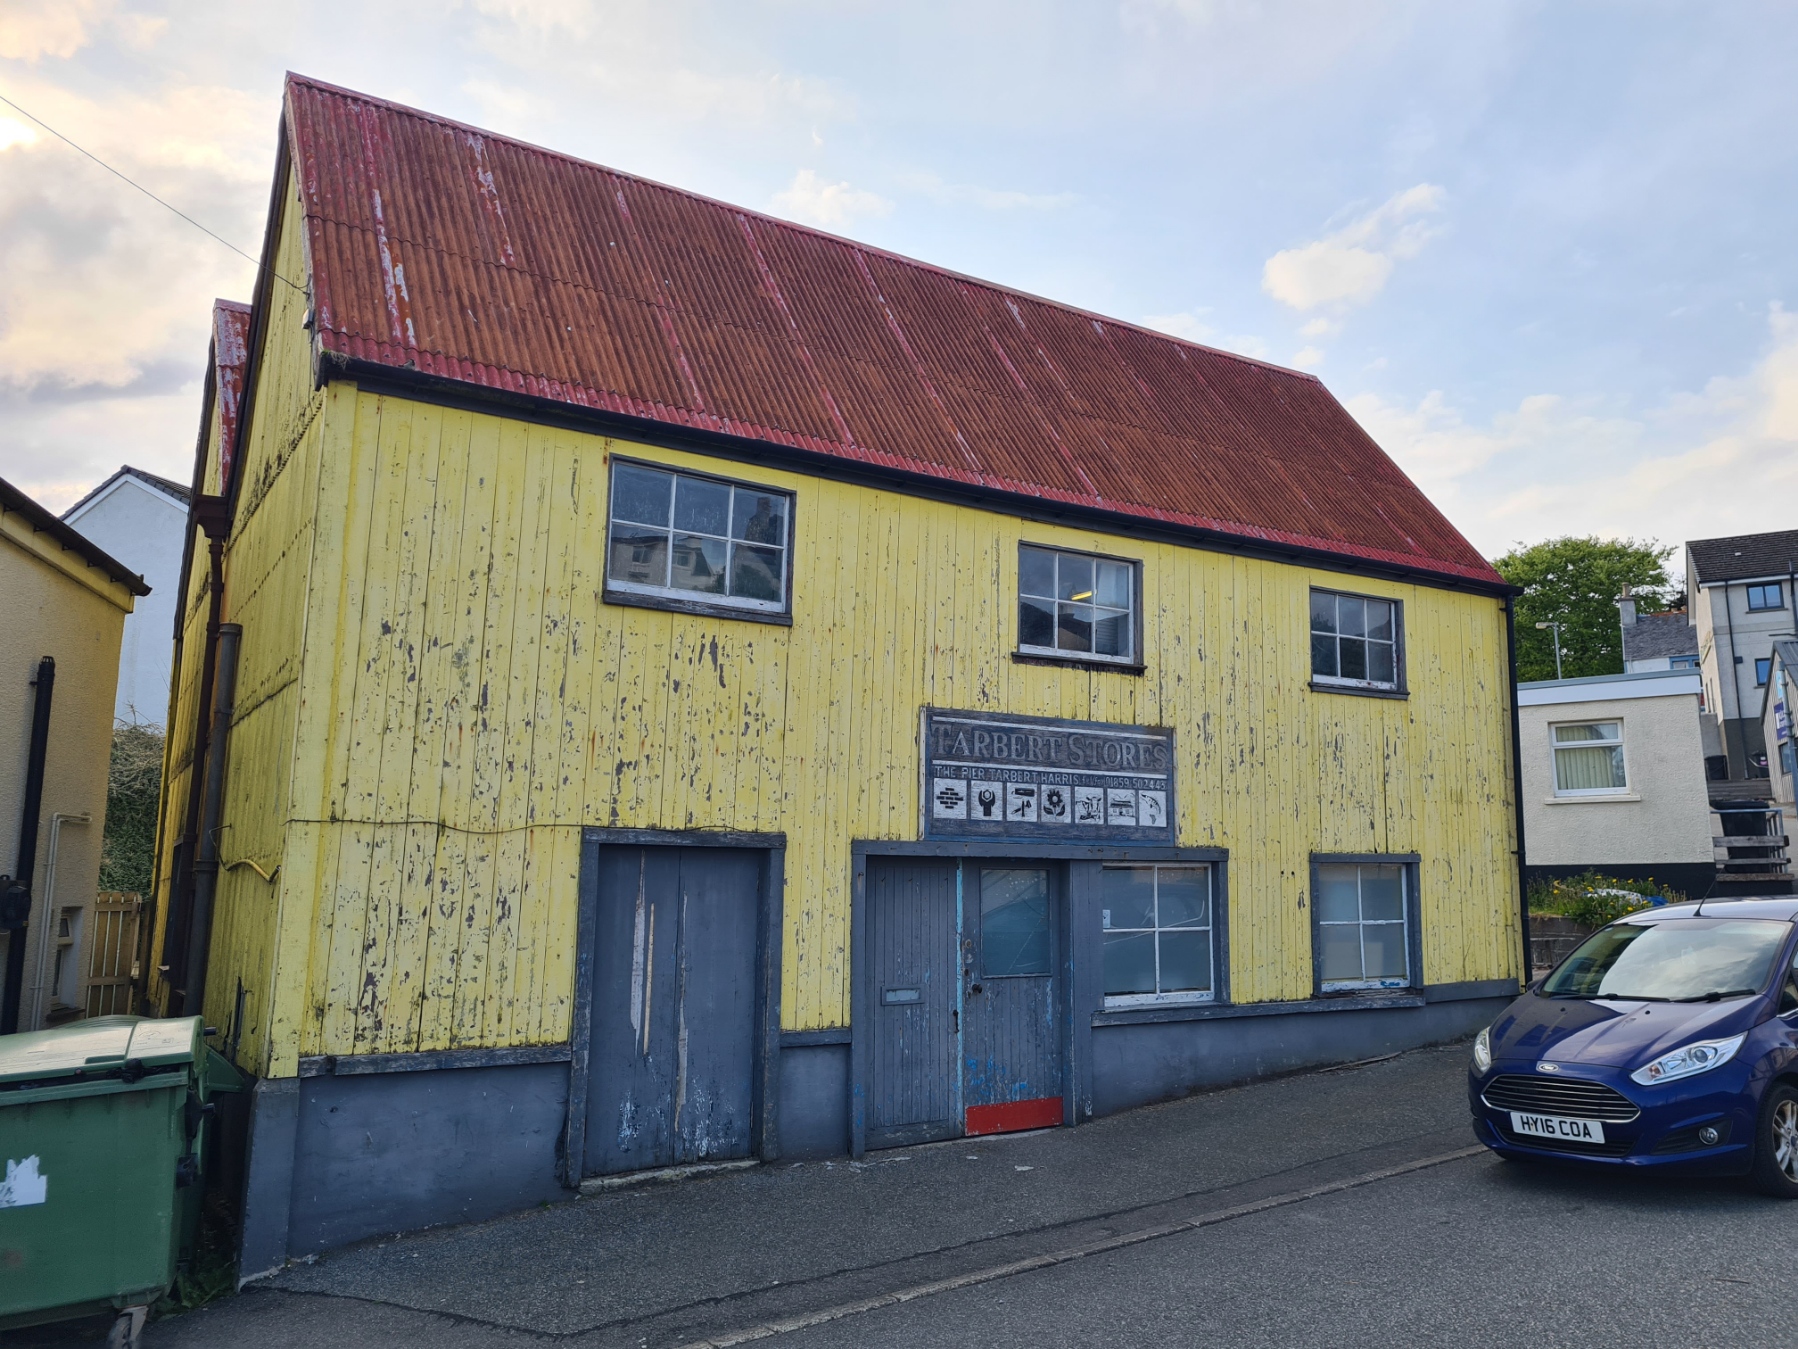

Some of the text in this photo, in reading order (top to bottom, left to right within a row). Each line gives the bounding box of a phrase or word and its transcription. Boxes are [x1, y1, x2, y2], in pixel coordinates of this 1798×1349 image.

[931, 723, 1168, 770] TARBERT STORES
[934, 765, 956, 778] THE
[1520, 1115, 1593, 1139] HY16 COA
